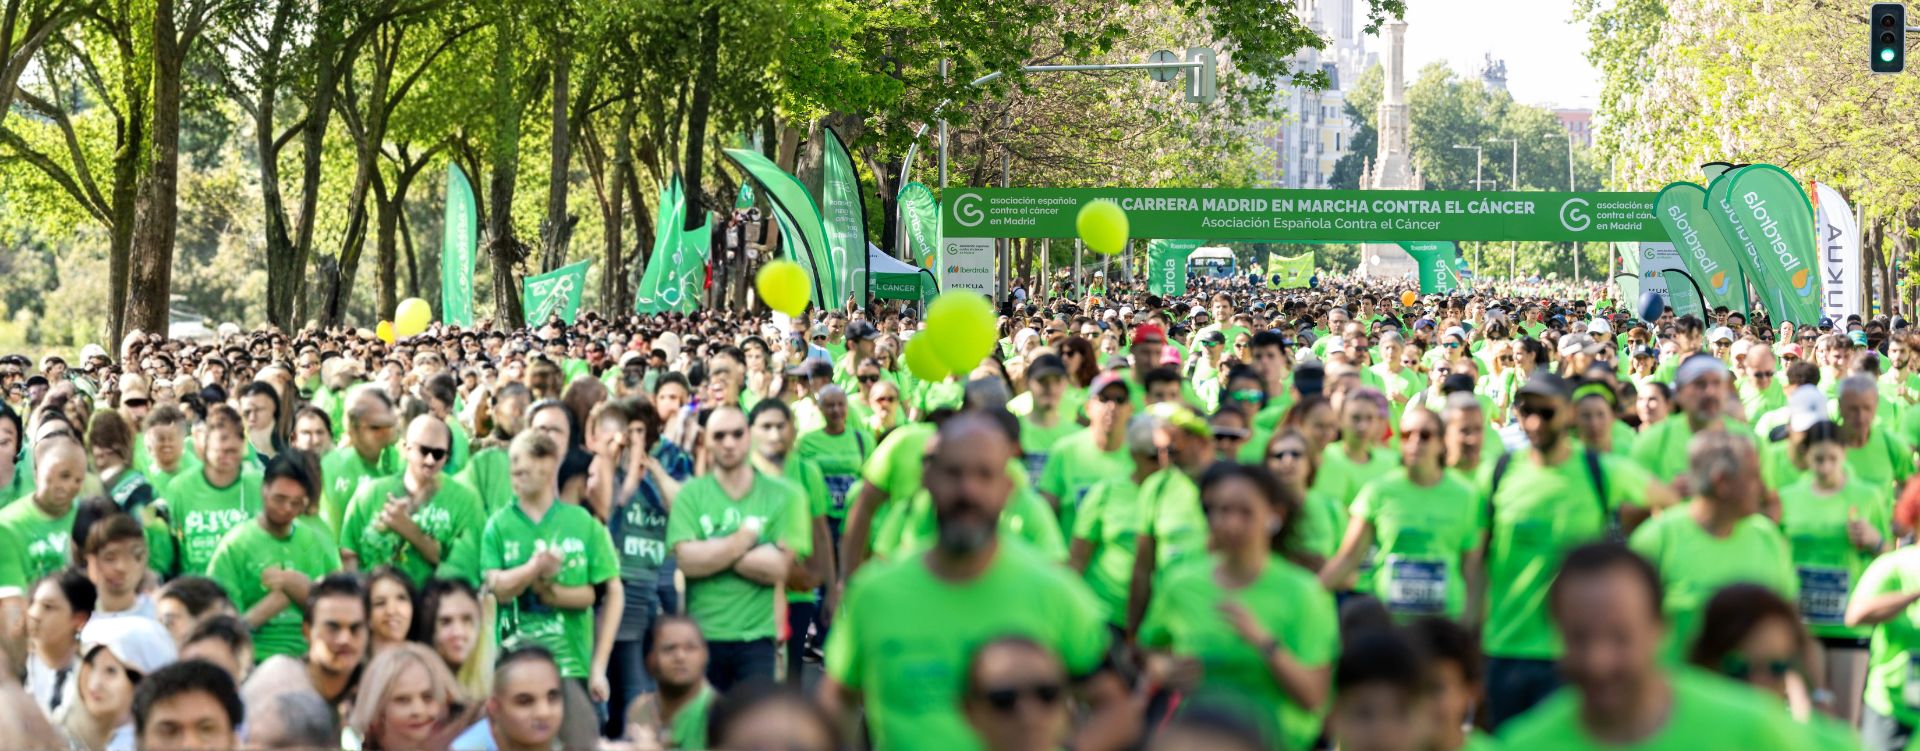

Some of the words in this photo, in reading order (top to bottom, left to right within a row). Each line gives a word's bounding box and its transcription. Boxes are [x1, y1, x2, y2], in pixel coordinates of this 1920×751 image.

[990, 196, 1035, 205] asociación
[1037, 196, 1077, 208] española
[1122, 198, 1199, 211] CARRERA
[1202, 199, 1268, 212] MADRID
[1272, 199, 1294, 212] EN
[1298, 199, 1369, 213] MARCHA
[1372, 200, 1442, 214] CONTRA
[1445, 200, 1465, 214] EL
[1467, 197, 1535, 215] CÁNCER
[1596, 200, 1642, 209] asociación
[990, 207, 1018, 215] contra
[1020, 206, 1028, 215] el
[1029, 206, 1059, 215] cáncer
[1596, 211, 1624, 219] contra
[1626, 211, 1634, 219] el
[1003, 216, 1036, 225] Madrid
[1201, 216, 1270, 228] Asociación
[1273, 217, 1331, 230] Española
[1334, 218, 1378, 229] Contra
[1381, 218, 1393, 229] el
[1395, 218, 1440, 230] Cáncer
[1610, 222, 1642, 230] Madrid
[1163, 258, 1176, 294] drola
[1433, 259, 1447, 294] drola
